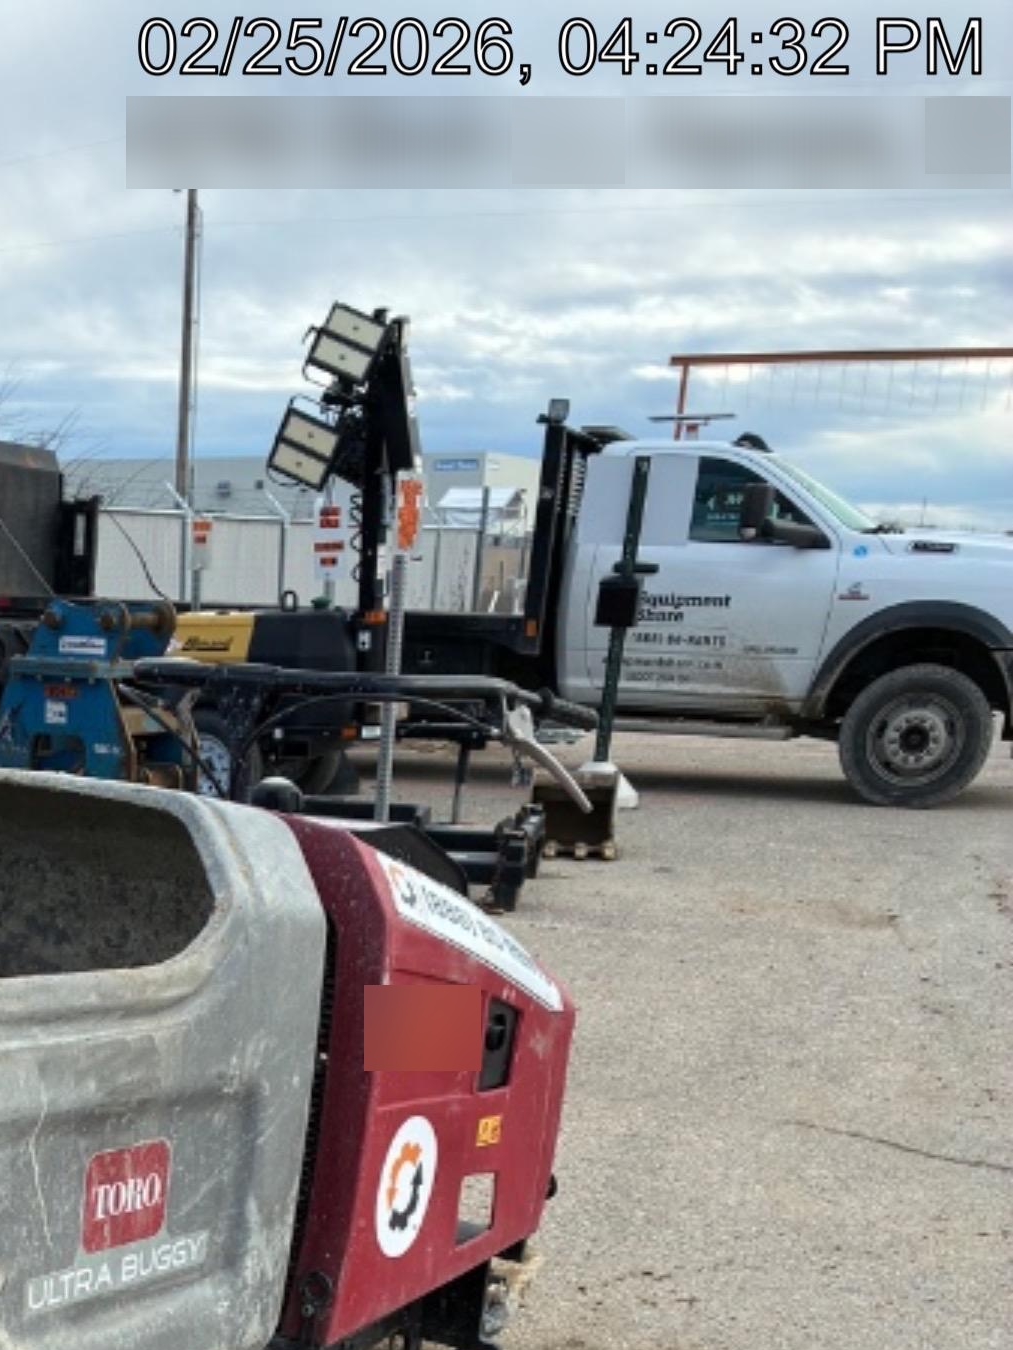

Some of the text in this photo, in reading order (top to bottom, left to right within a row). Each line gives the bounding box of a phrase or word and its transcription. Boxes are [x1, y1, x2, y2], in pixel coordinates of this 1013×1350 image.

[94, 1172, 162, 1220] TORO
[27, 1233, 207, 1310] ULTRA BUGGY
